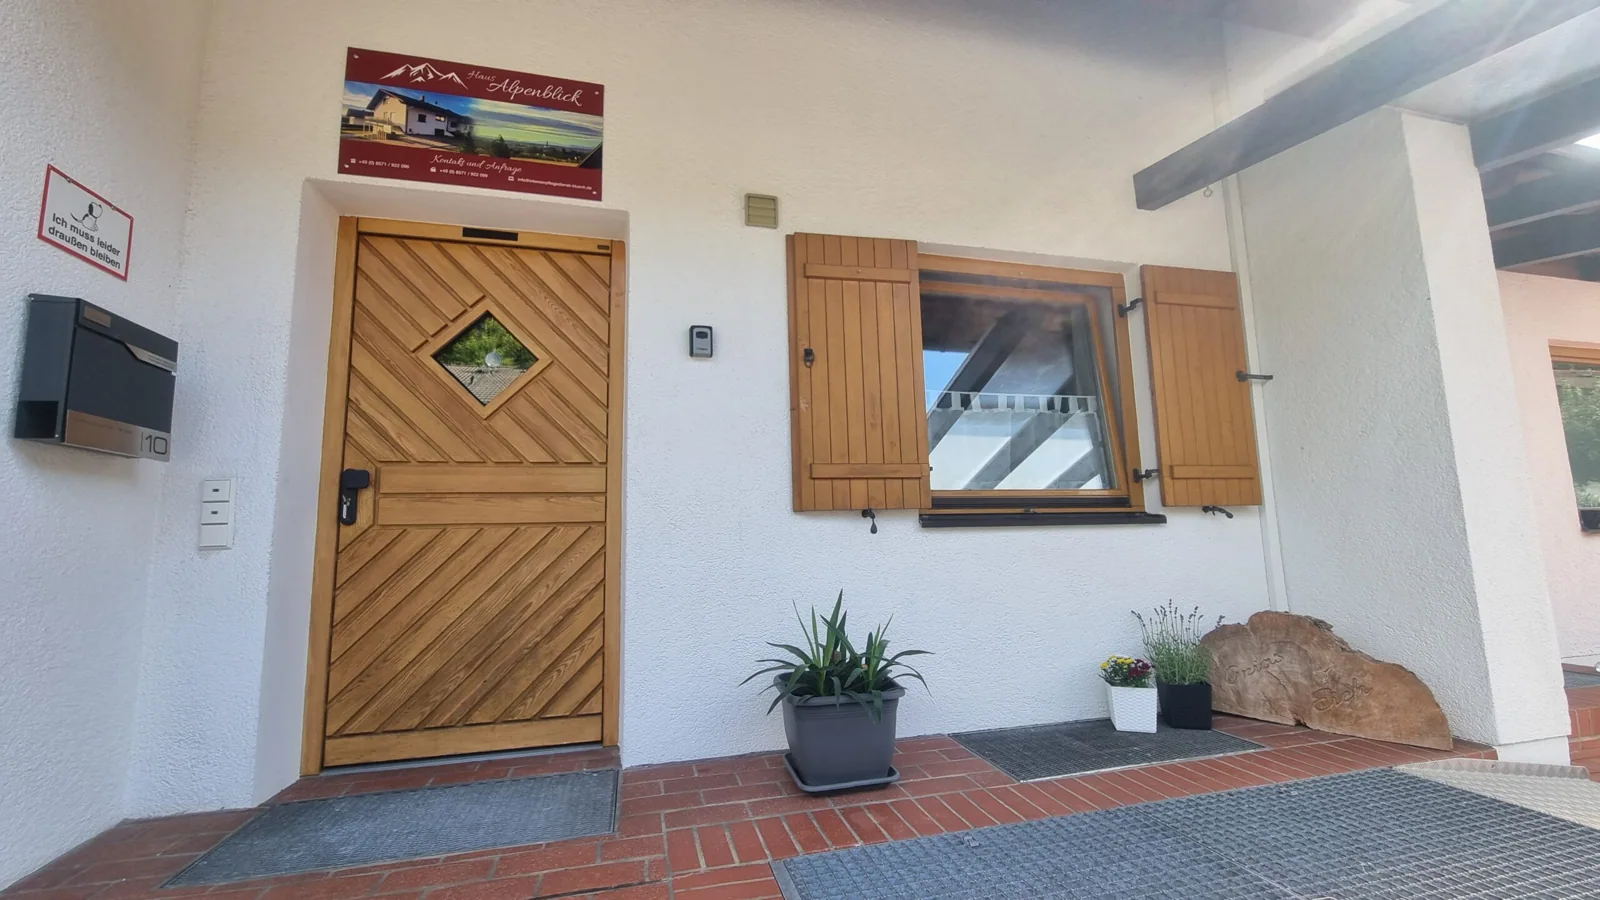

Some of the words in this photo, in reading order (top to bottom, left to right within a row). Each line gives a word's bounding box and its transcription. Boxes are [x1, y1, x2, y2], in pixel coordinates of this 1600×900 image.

[467, 70, 496, 81] Haus
[486, 79, 582, 106] Alpenblick
[430, 154, 465, 167] Kontakt
[466, 160, 486, 169] und
[485, 161, 522, 175] Anfrage
[52, 212, 67, 228] Ich
[70, 224, 95, 243] muss
[97, 237, 121, 256] leider
[48, 226, 88, 252] draußen
[90, 246, 121, 269] bleiben
[145, 434, 168, 455] 10
